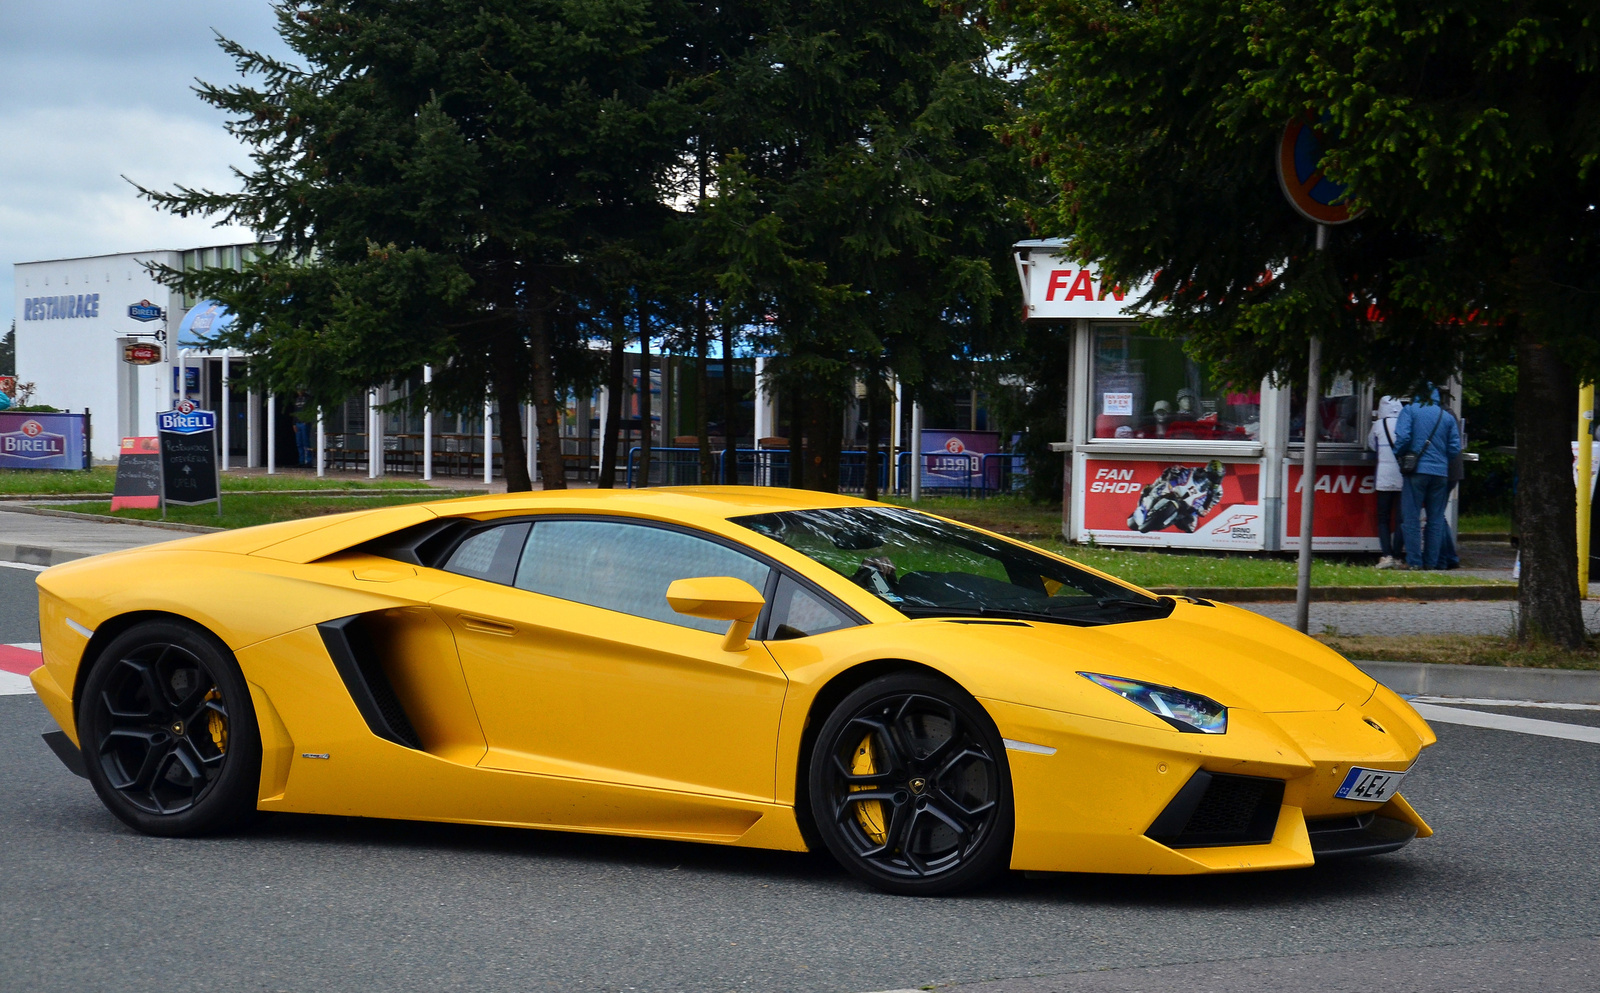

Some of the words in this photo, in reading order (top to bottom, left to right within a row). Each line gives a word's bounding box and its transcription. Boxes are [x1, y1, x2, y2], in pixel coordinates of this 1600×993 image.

[24, 293, 99, 321] RESTAURACE
[131, 307, 159, 316] BIRELL
[162, 415, 211, 428] BIRELL
[4, 437, 60, 452] BIRELL
[1095, 468, 1134, 480] FAN
[1090, 481, 1142, 493] SHOP
[1339, 787, 1350, 795] CZ
[1354, 774, 1391, 798] 4E4
